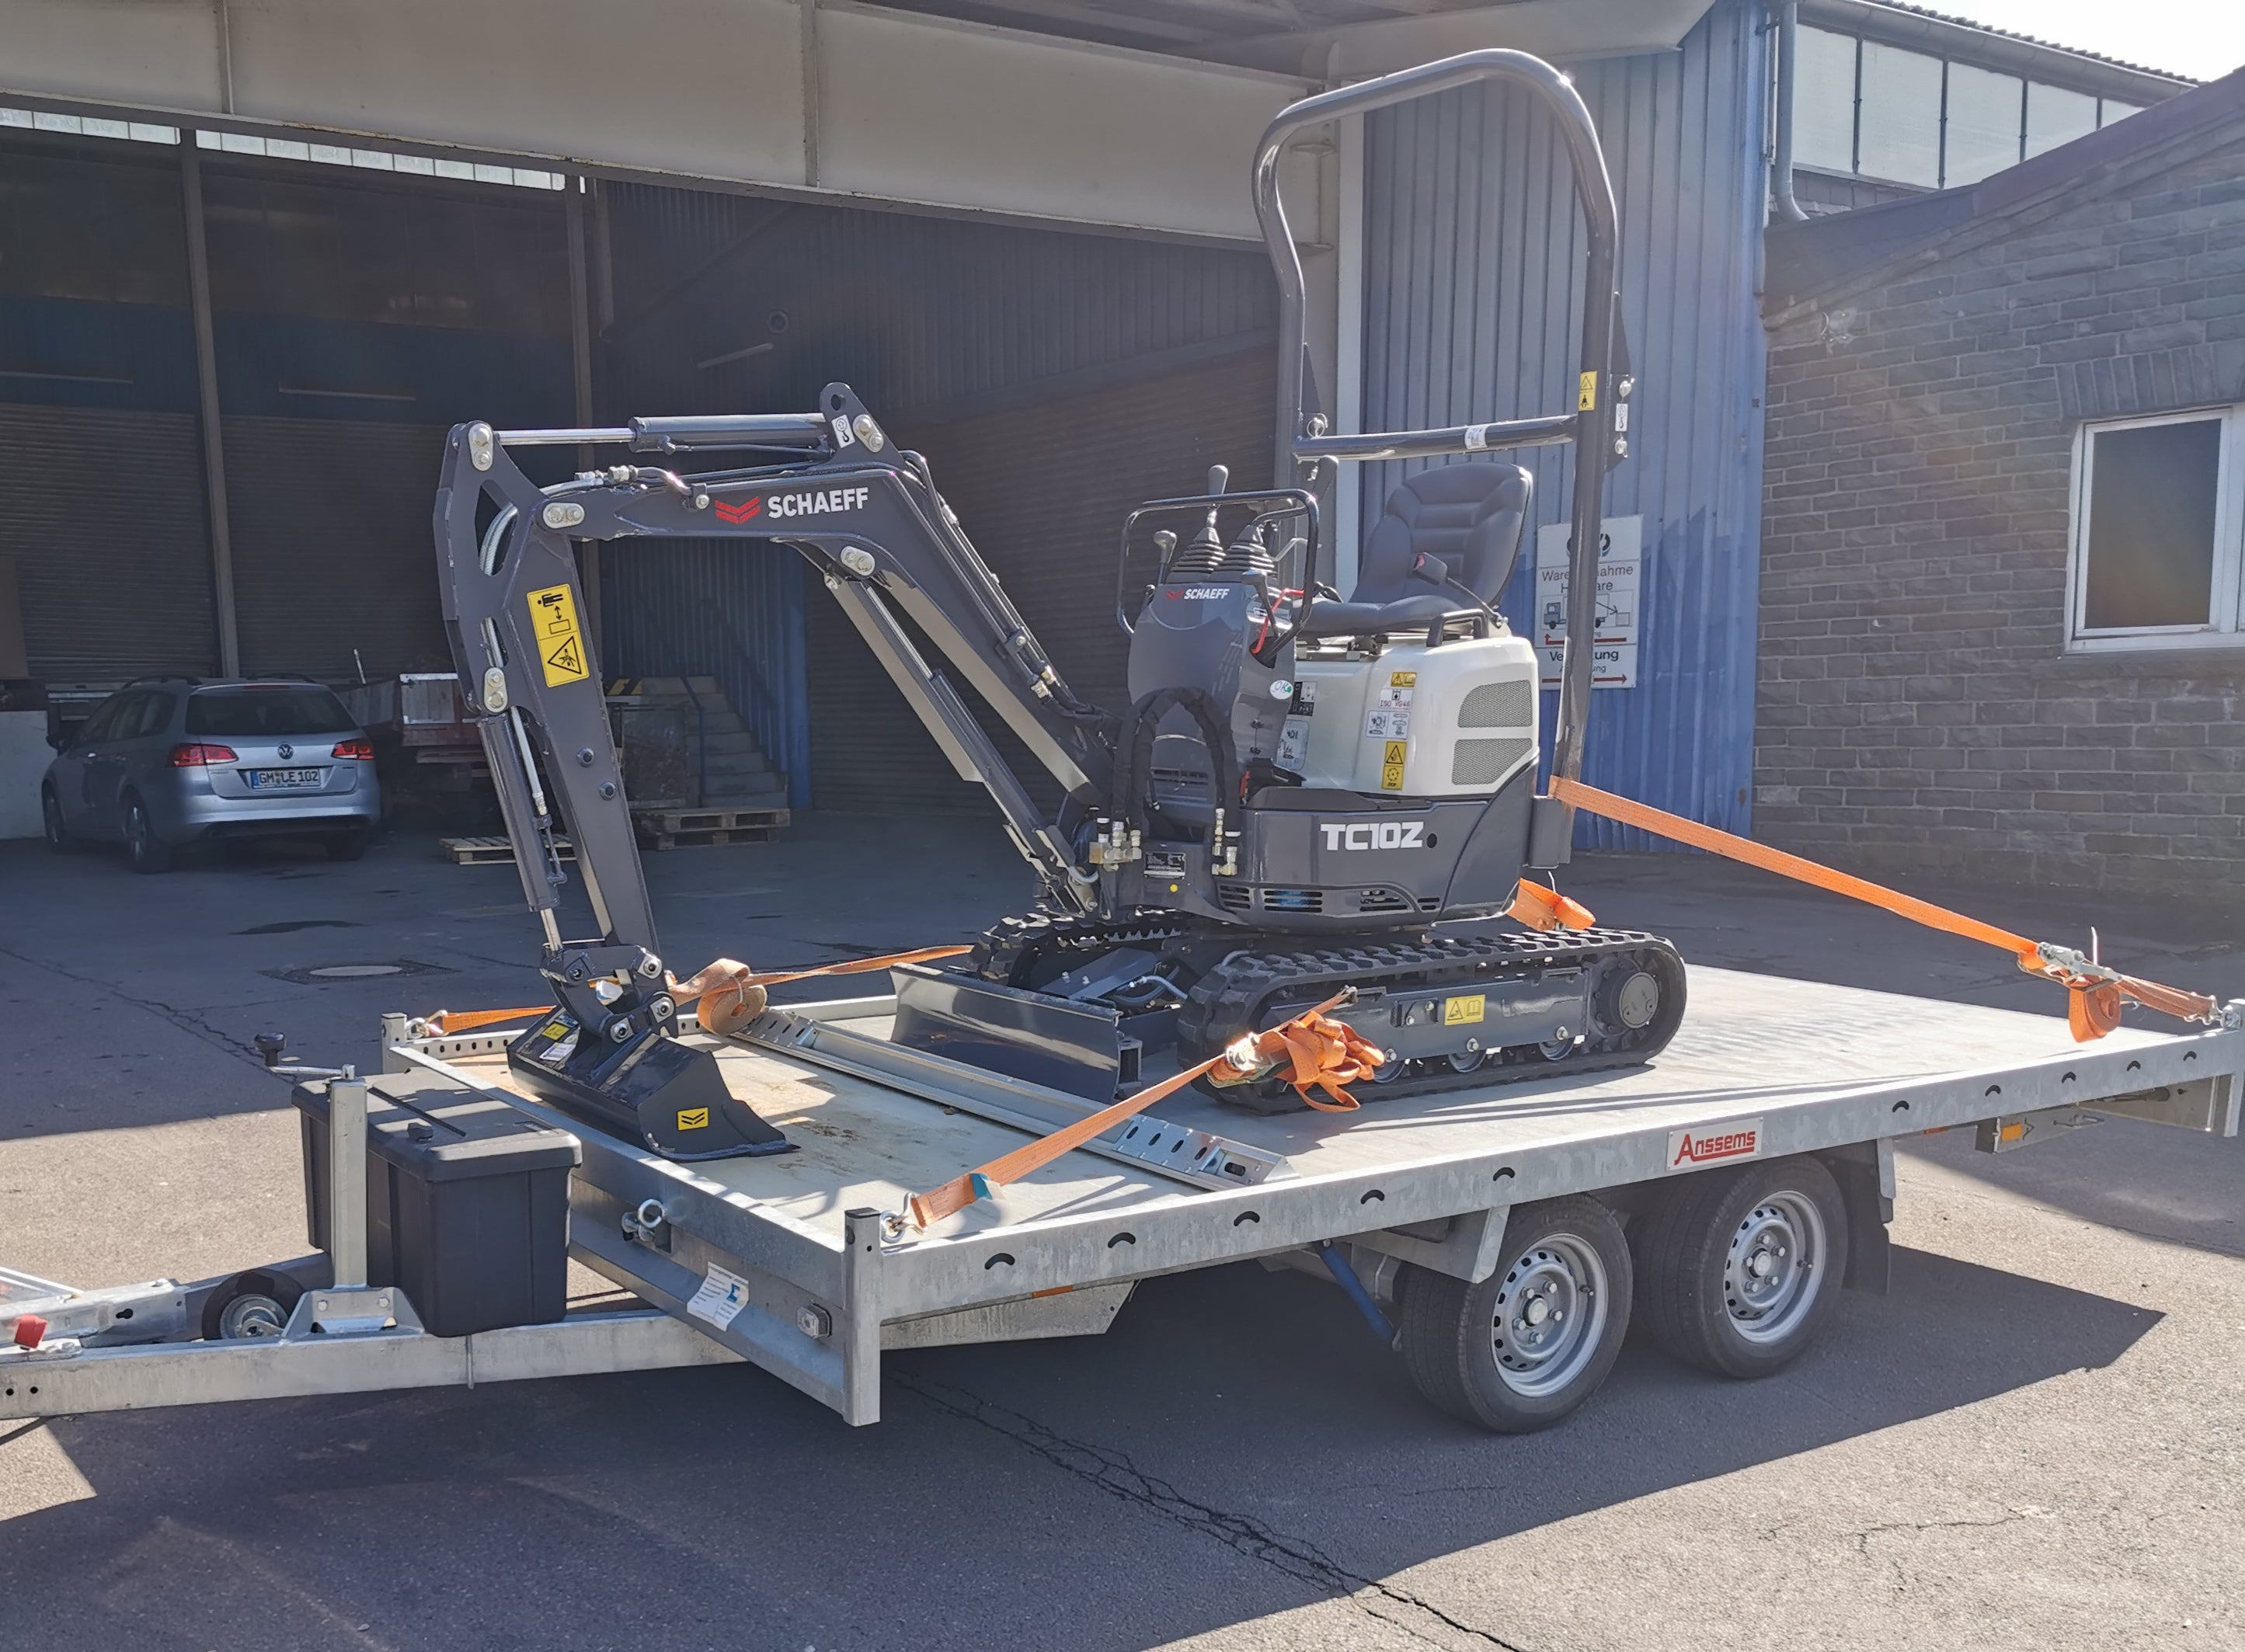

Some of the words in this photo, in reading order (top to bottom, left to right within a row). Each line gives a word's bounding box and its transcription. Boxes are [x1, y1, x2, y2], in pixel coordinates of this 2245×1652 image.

[767, 487, 868, 519] SCHAEFF
[1183, 588, 1230, 600] SCHAEFF
[259, 773, 273, 784] GM
[280, 771, 295, 783] LE
[298, 771, 318, 782] 102
[1320, 821, 1424, 850] TC10Z
[1674, 1131, 1756, 1165] Anssems
